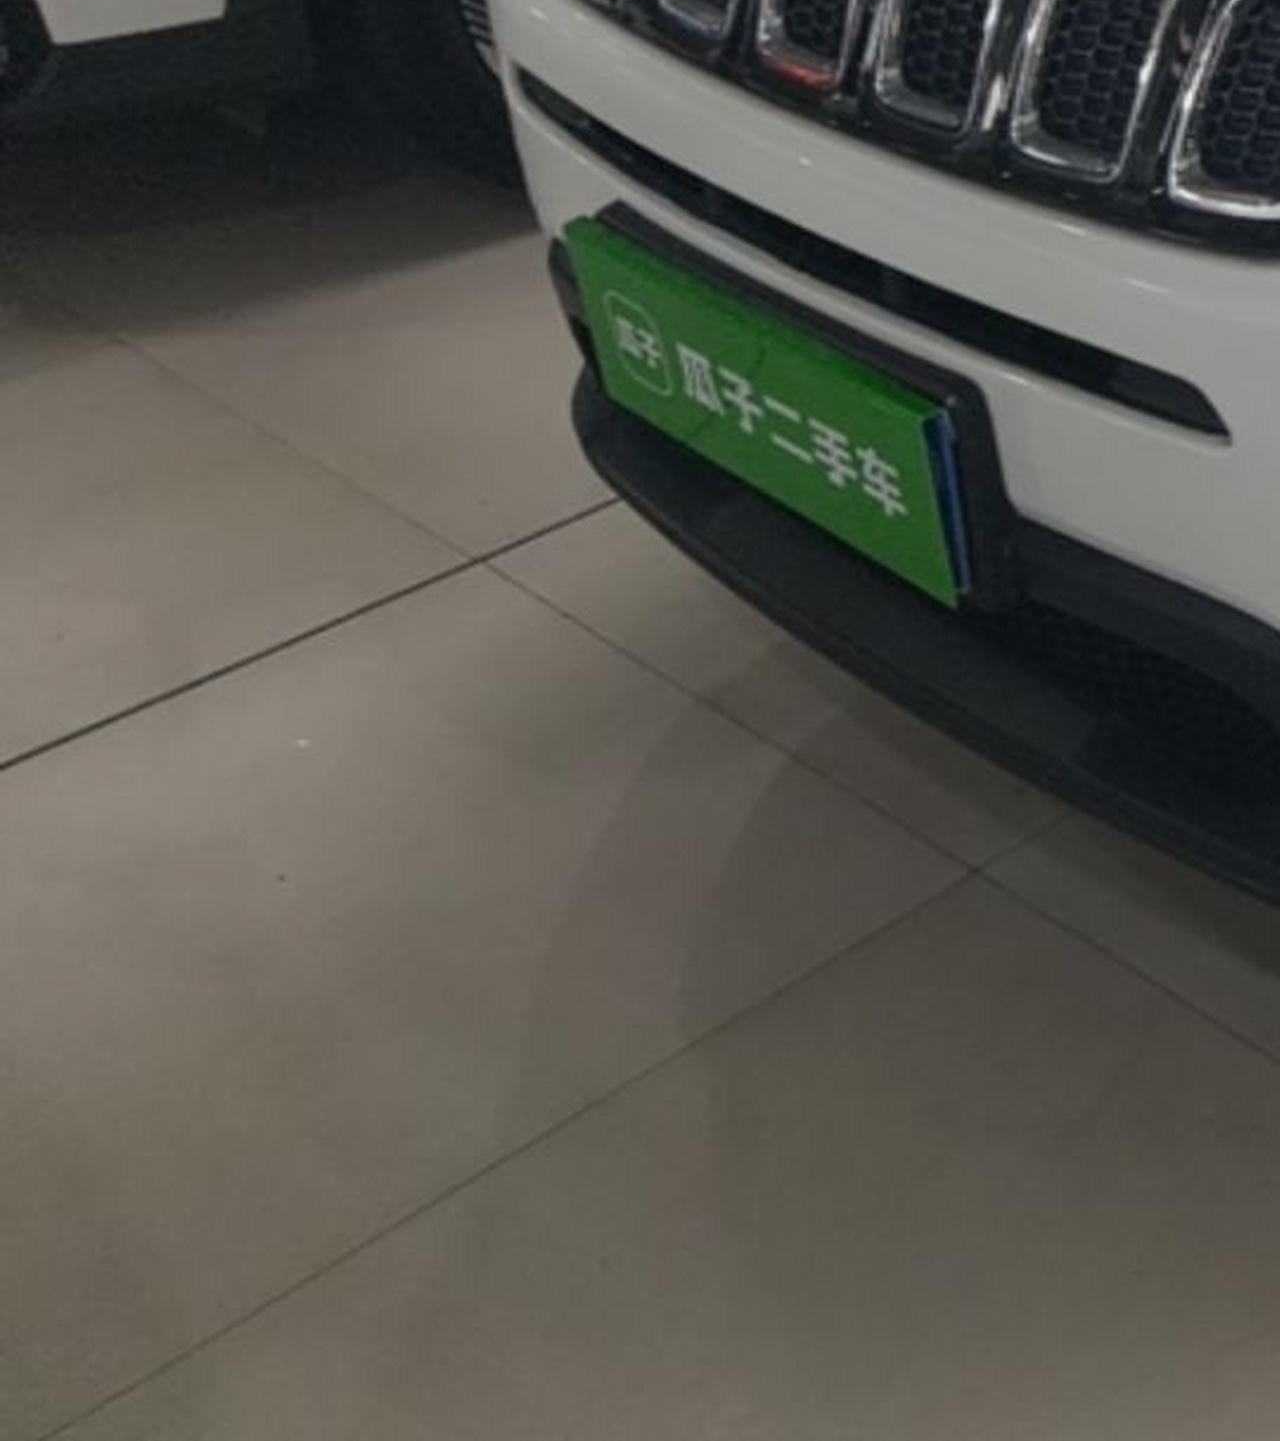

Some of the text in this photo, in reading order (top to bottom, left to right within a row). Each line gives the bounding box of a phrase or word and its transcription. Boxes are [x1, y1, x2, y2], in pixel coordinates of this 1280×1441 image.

[675, 341, 908, 518] 瓜子二手车
